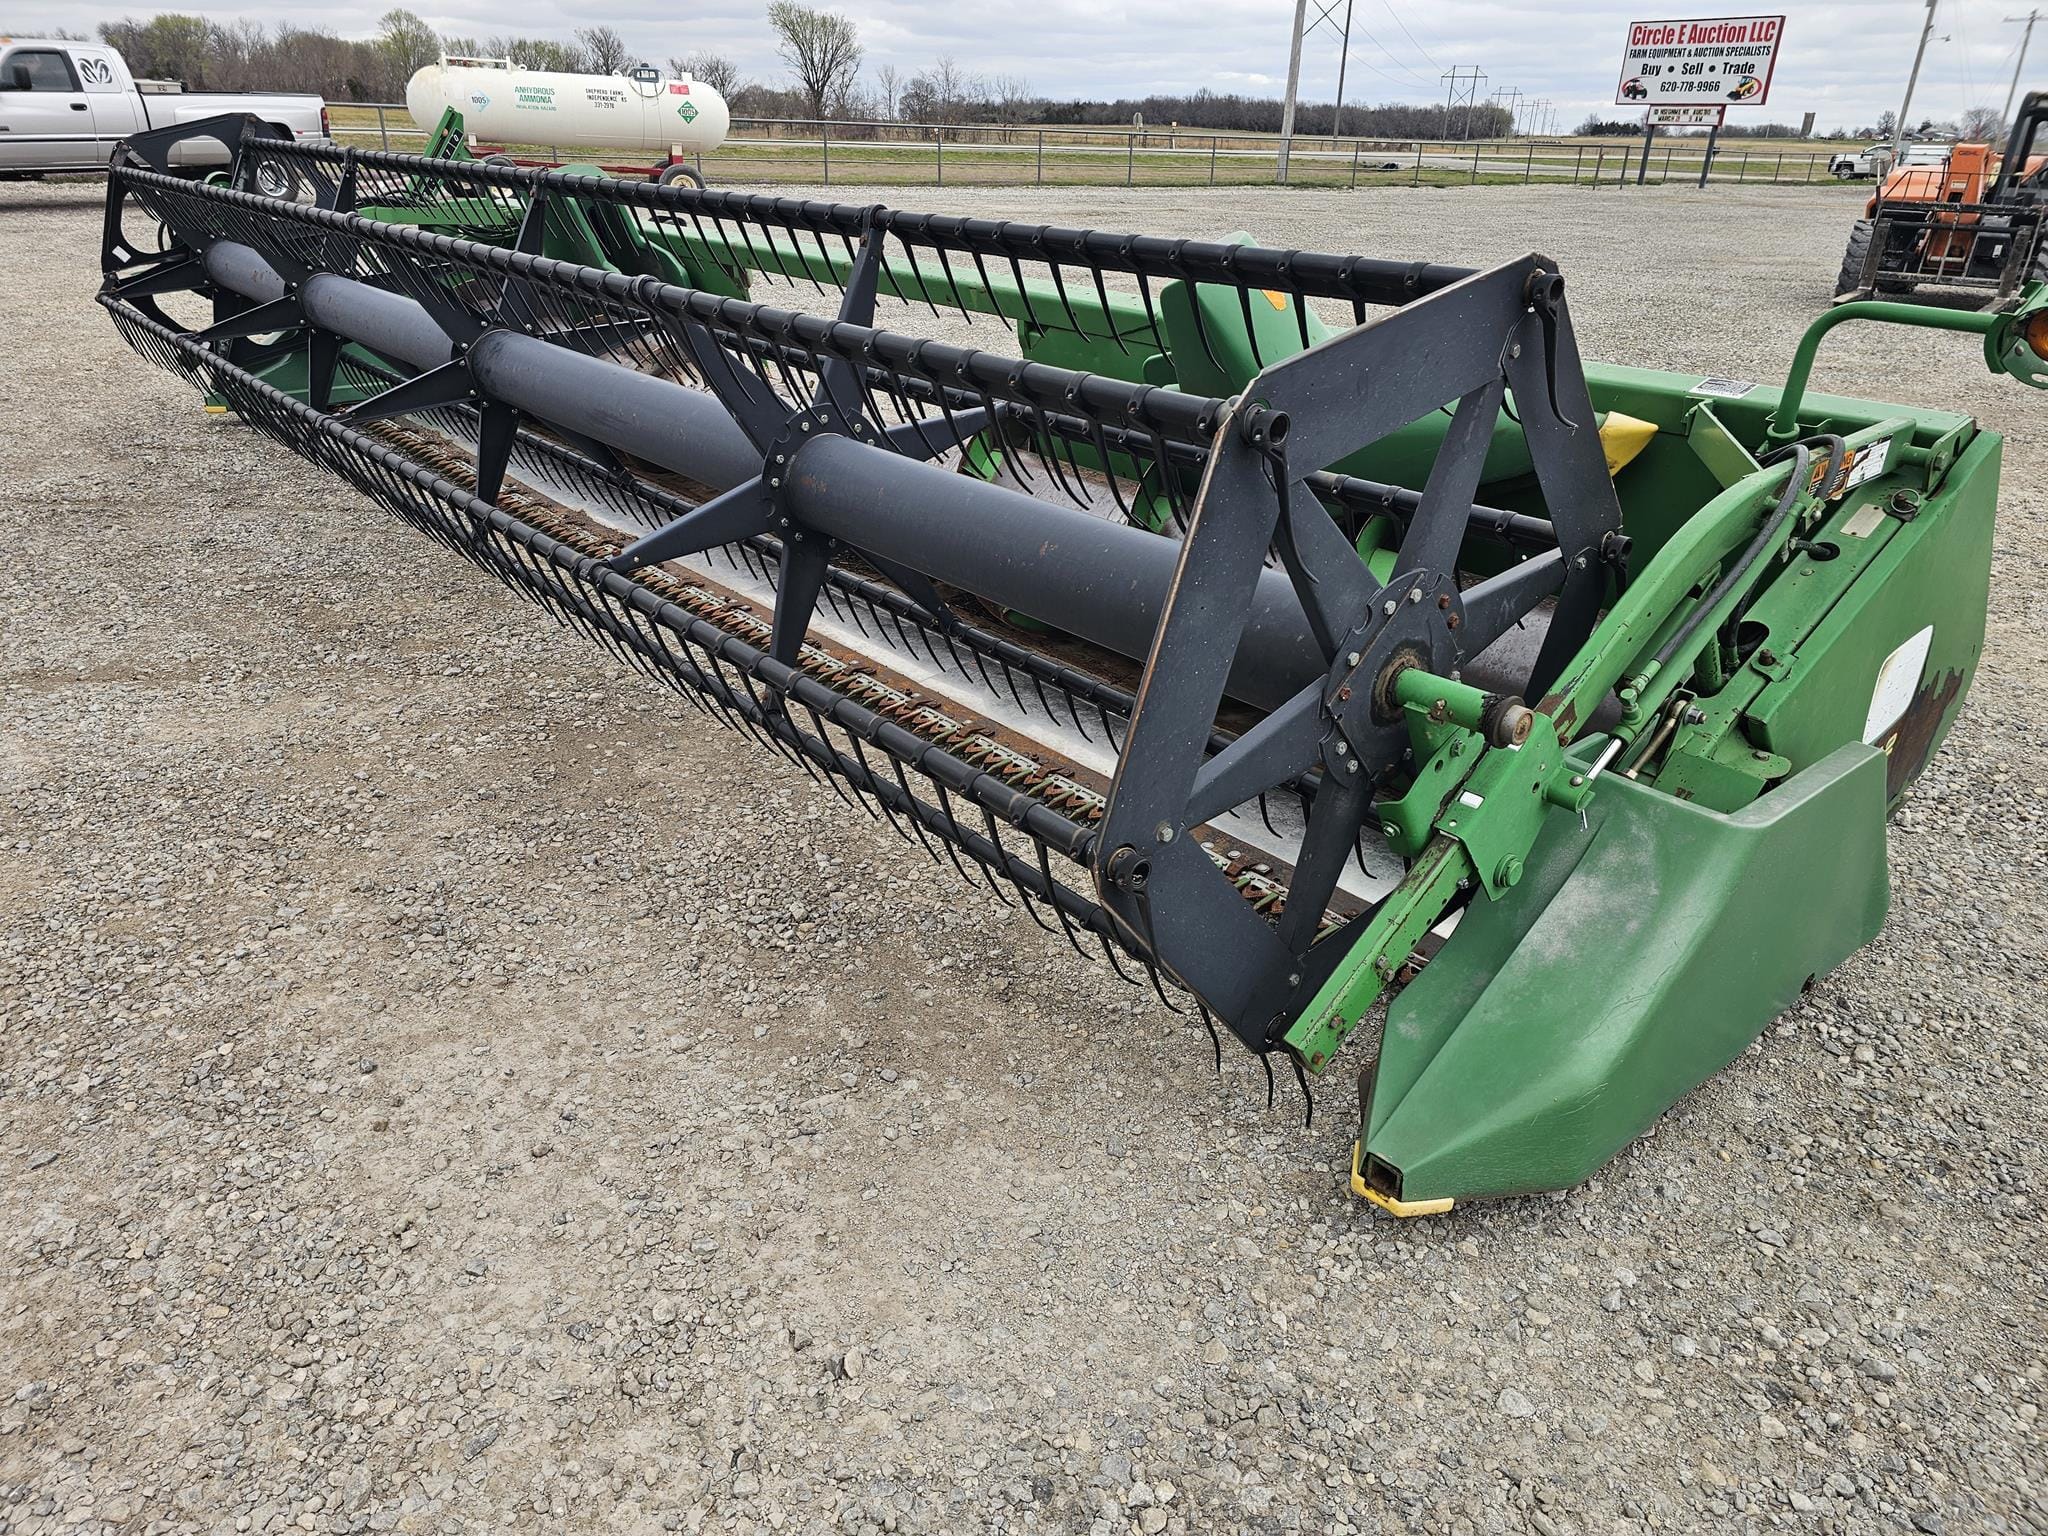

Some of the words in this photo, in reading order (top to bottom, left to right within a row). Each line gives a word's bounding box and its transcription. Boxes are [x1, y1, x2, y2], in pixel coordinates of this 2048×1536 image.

[1631, 25, 1675, 46] Circle
[1677, 24, 1687, 44] E
[1687, 22, 1747, 44] Auction
[1749, 20, 1776, 43] LLC
[1629, 48, 1647, 59] FARM
[1648, 47, 1687, 58] EQUIPMENT
[1687, 49, 1692, 58] &
[1693, 46, 1725, 58] AUCTION
[1725, 45, 1771, 57] SPECIALISTS
[1641, 63, 1661, 77] Buy
[1681, 62, 1704, 75] Sell
[1722, 61, 1755, 75] Trade
[515, 86, 555, 96] ANHYDROUS
[1660, 81, 1721, 92] 620-778-9966
[471, 96, 487, 104] 1005
[519, 94, 552, 104] AMMONIA
[681, 108, 695, 116] 1005
